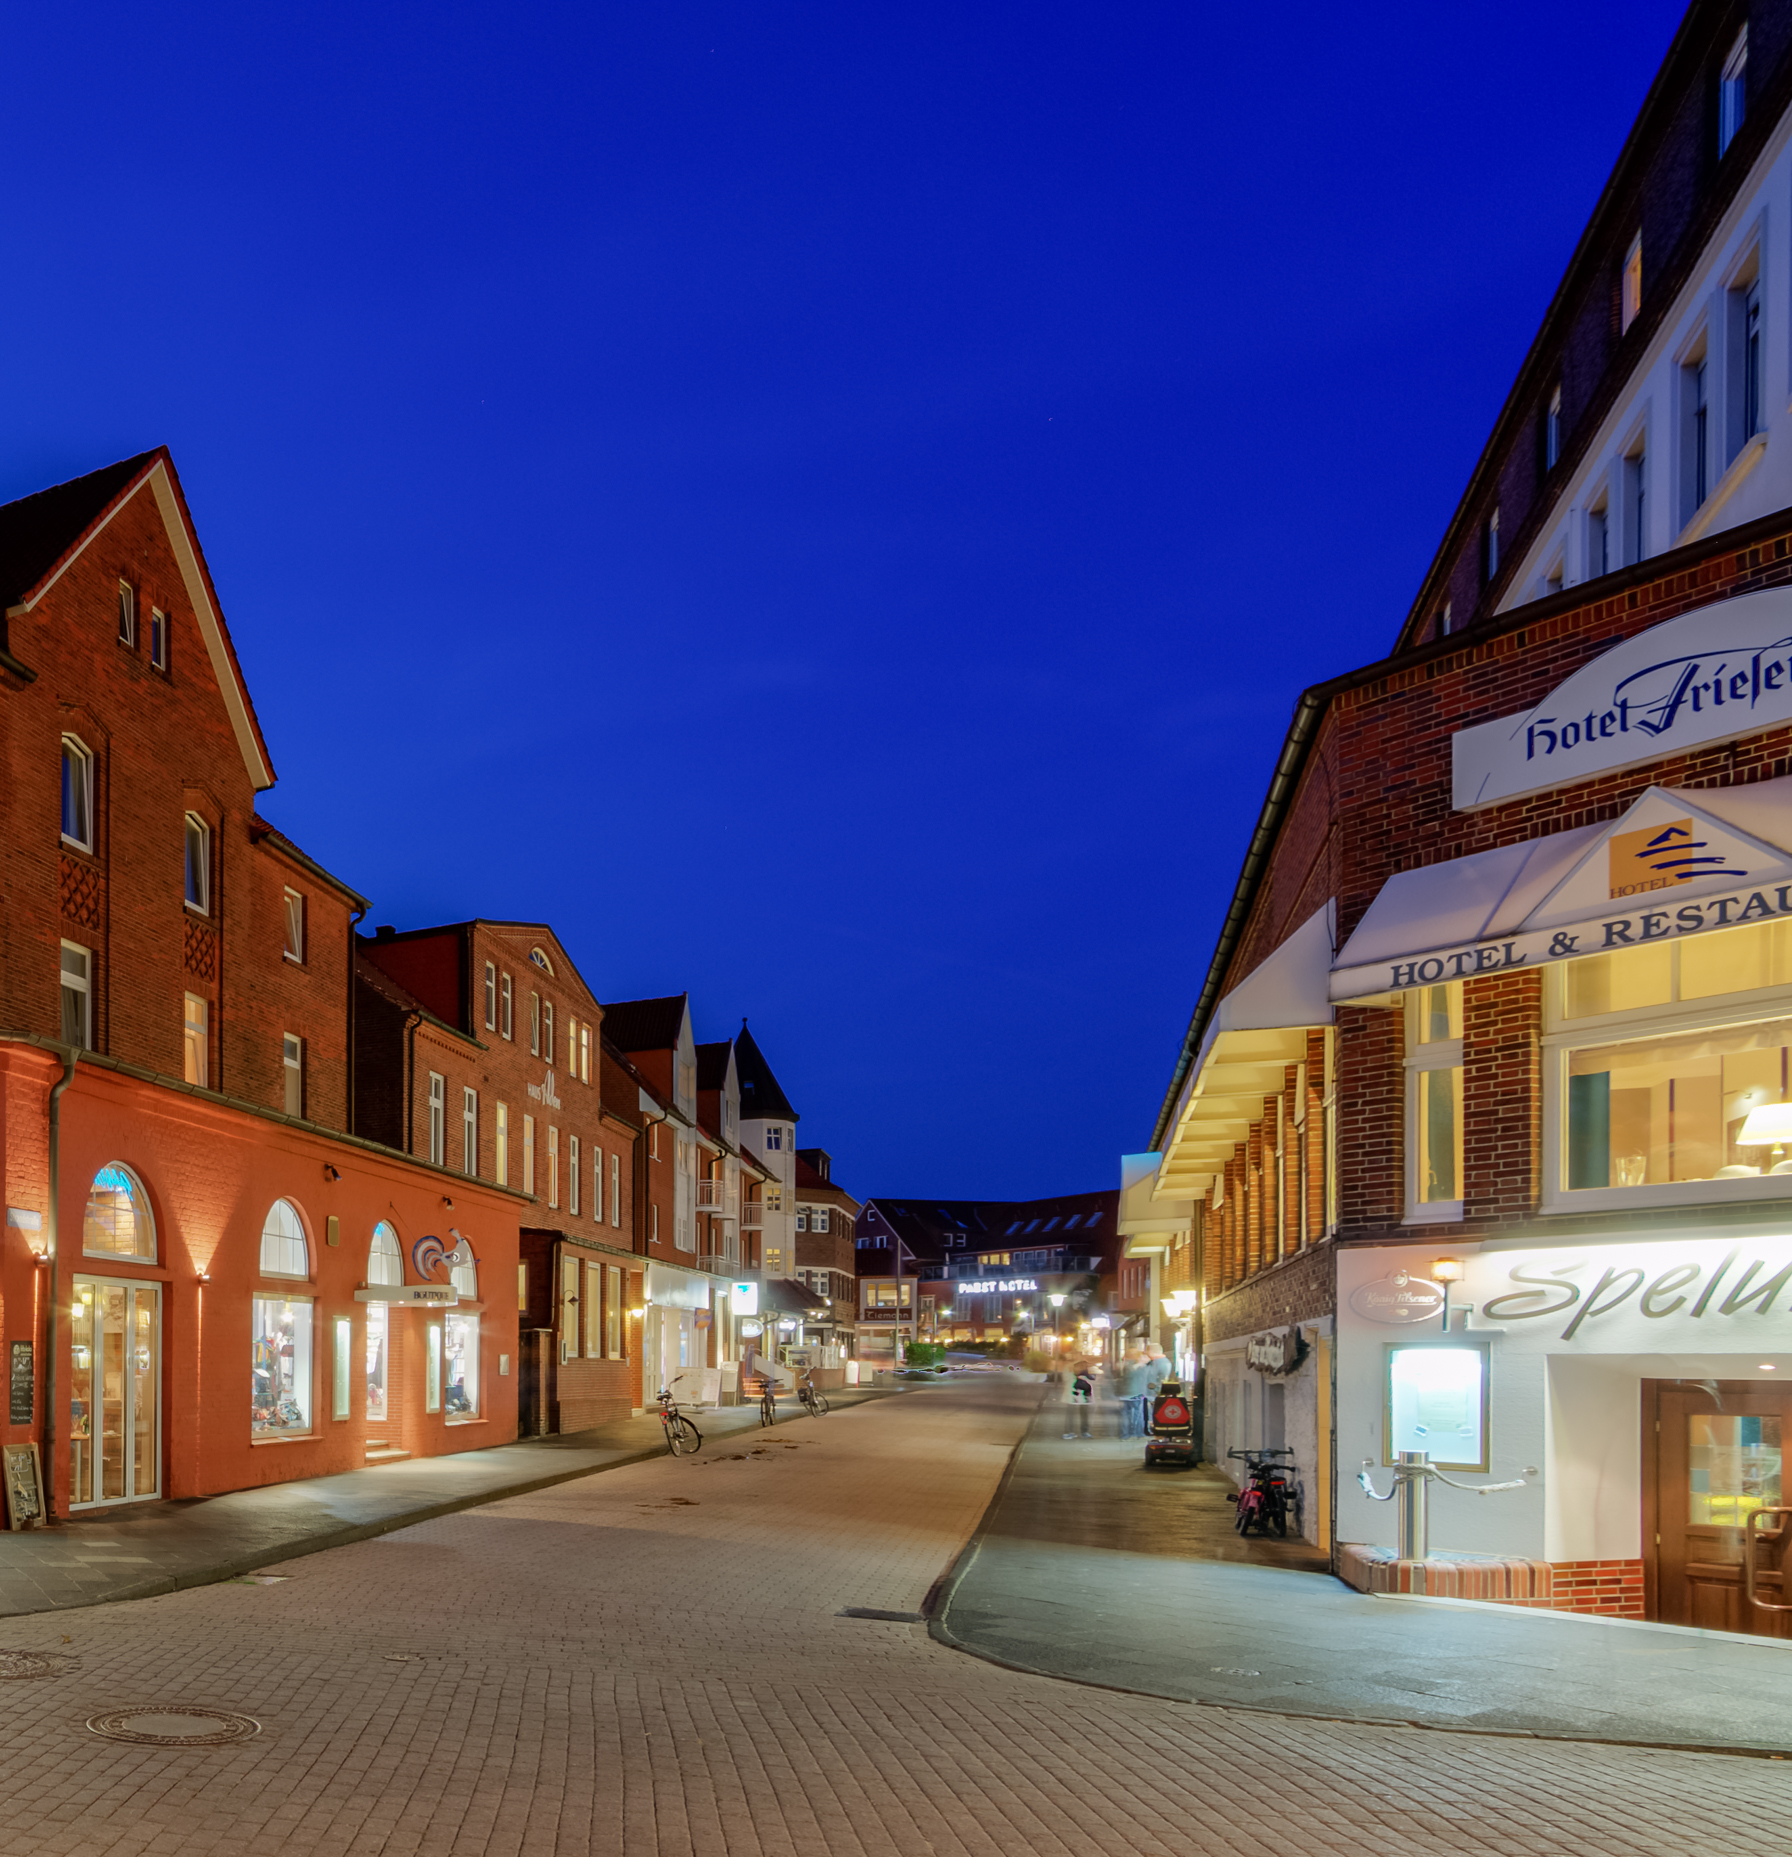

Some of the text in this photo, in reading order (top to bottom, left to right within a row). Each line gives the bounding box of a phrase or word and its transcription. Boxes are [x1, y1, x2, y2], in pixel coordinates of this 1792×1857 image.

[1527, 635, 1792, 762] Hotel Friese
[1609, 877, 1674, 900] HOTEL
[1390, 941, 1527, 988] HOTEL
[1548, 932, 1580, 957] &
[527, 1082, 541, 1101] HAUS
[413, 1291, 449, 1301] BOUTIQUE
[1482, 1244, 1792, 1342] Spelu
